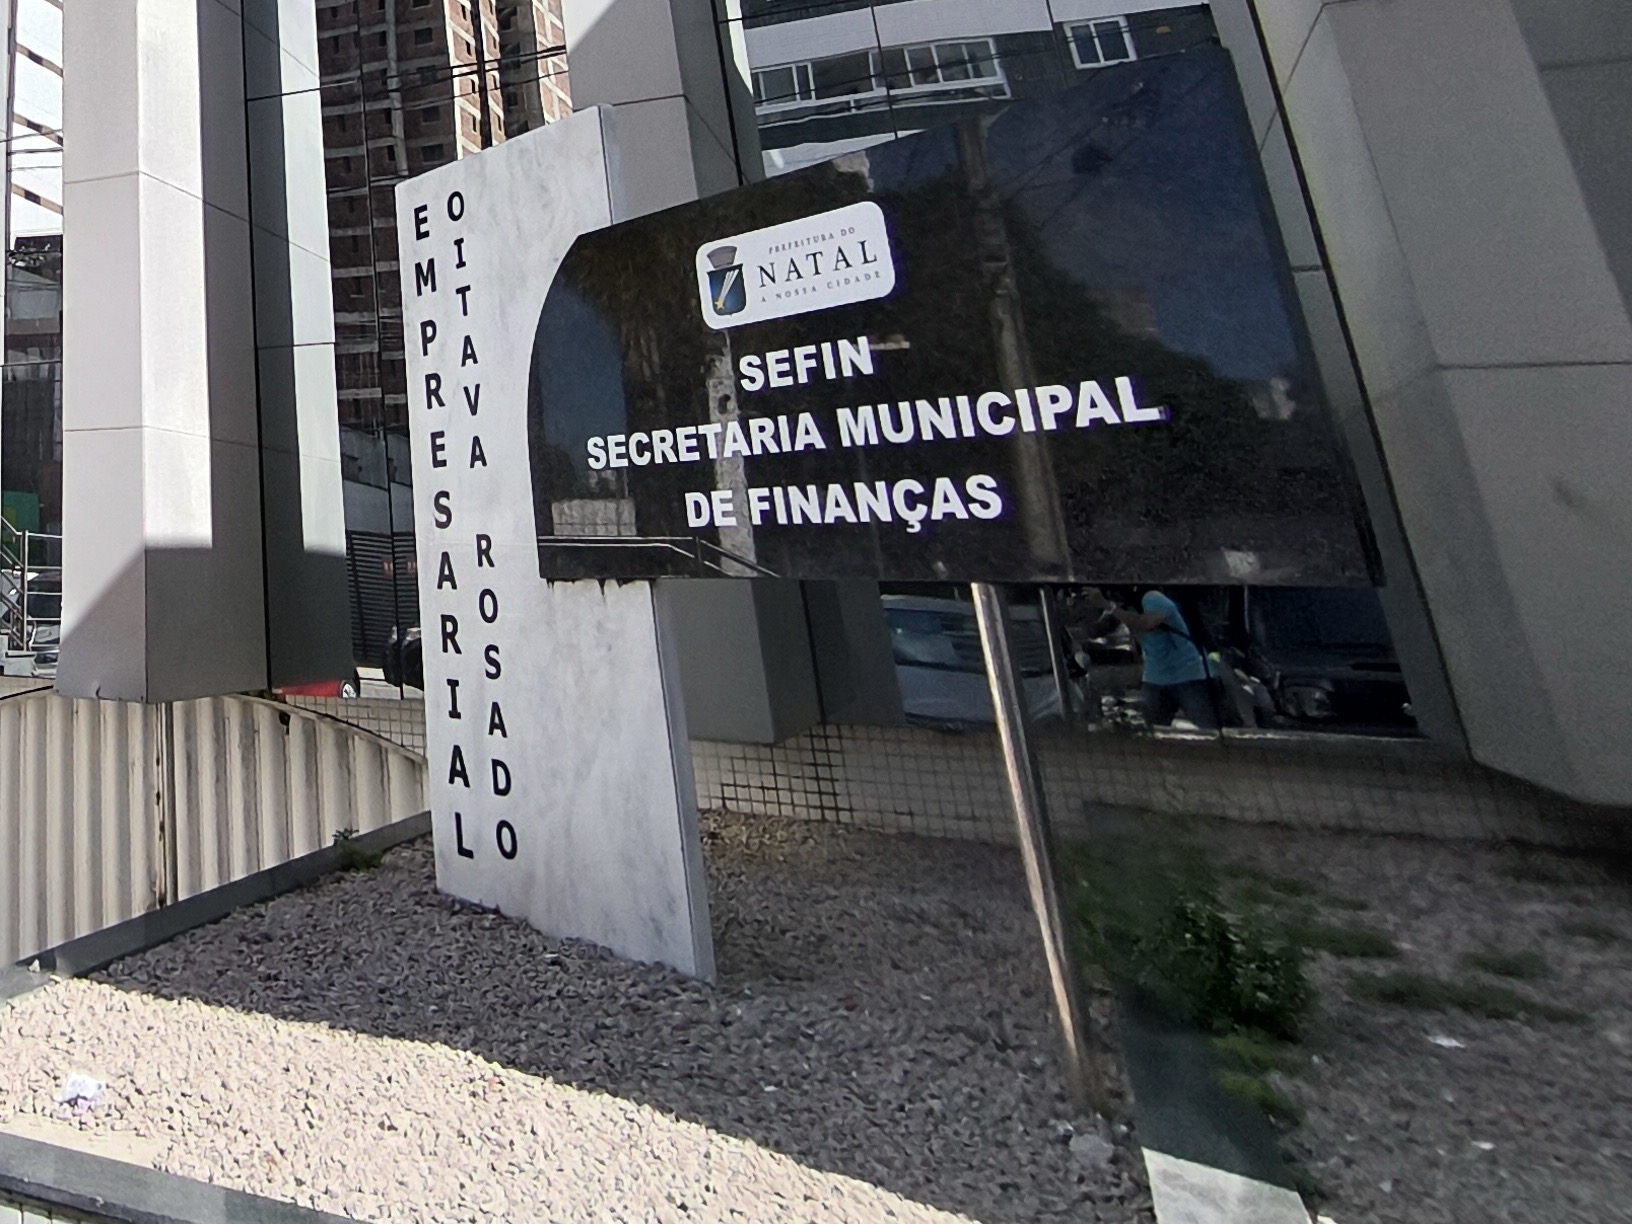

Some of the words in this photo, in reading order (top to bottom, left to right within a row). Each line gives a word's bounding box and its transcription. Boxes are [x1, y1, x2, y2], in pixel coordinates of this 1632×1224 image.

[757, 239, 878, 288] NATAL
[769, 233, 834, 254] PREFEITURA
[841, 227, 855, 236] DO
[761, 295, 767, 303] A
[776, 285, 818, 300] NOSSA
[826, 270, 881, 290] CIDADE
[739, 335, 875, 392] SEFIN
[586, 411, 826, 470] SECRETARIA
[837, 376, 1162, 448] MUNICIPAL
[413, 203, 475, 860] EMPRESARIAL
[447, 190, 488, 469] OITAVA
[475, 533, 518, 861] ROSADO
[685, 489, 737, 528] DE
[749, 473, 1003, 533] FINANÇAS
